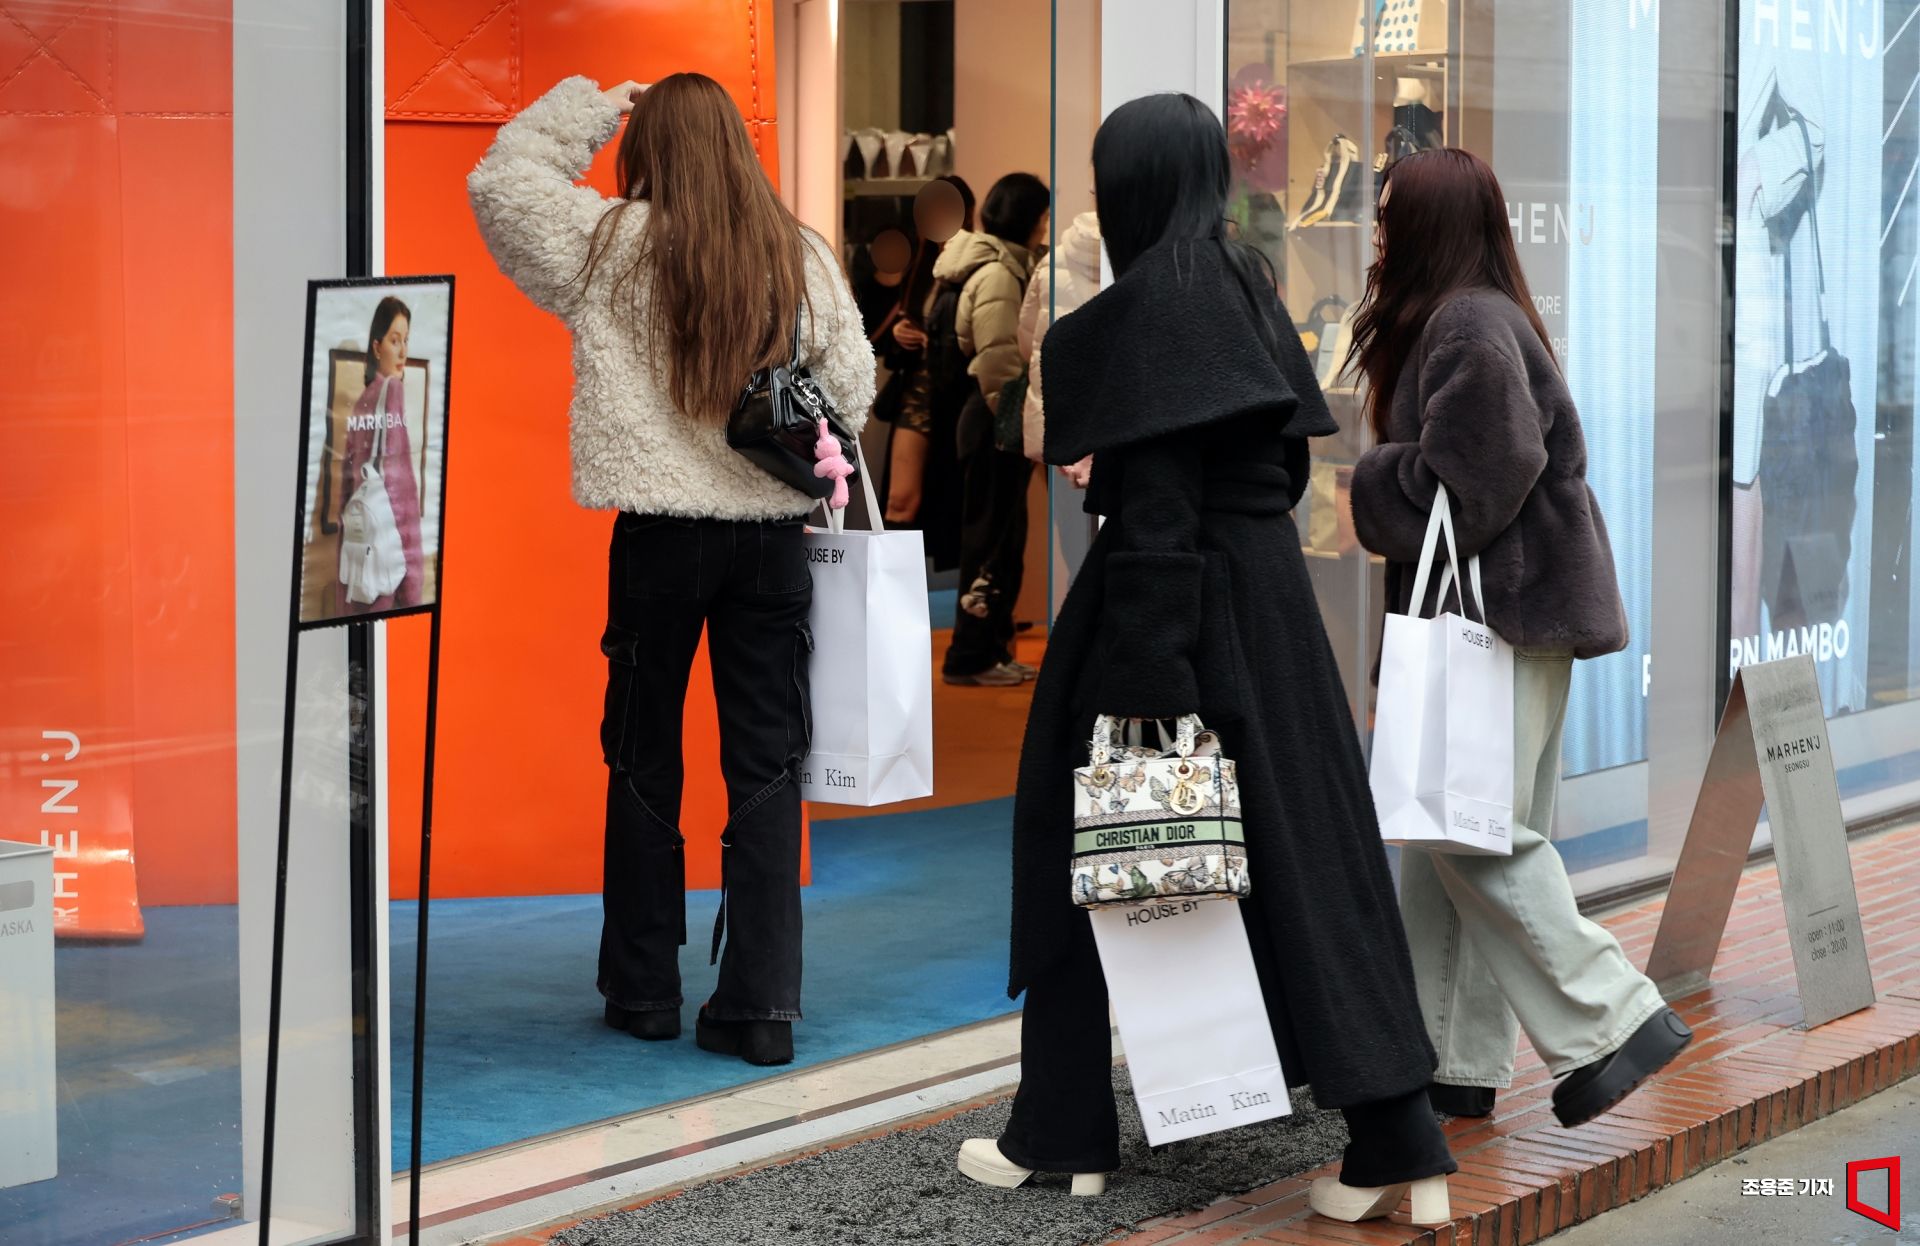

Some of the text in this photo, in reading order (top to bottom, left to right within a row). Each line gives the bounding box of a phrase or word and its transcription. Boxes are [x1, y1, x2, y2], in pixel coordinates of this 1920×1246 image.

[347, 414, 383, 432] MARK
[831, 549, 845, 564] BY
[1767, 619, 1850, 664] MAMBO
[1766, 735, 1821, 762] MARHEN'J
[825, 768, 856, 788] Kim
[1784, 759, 1810, 774] SEONGSU
[1096, 824, 1196, 848] CHRISTIAN DIOR
[1126, 901, 1199, 926] HOUSE BY
[1157, 1091, 1271, 1127] Matin Kim
